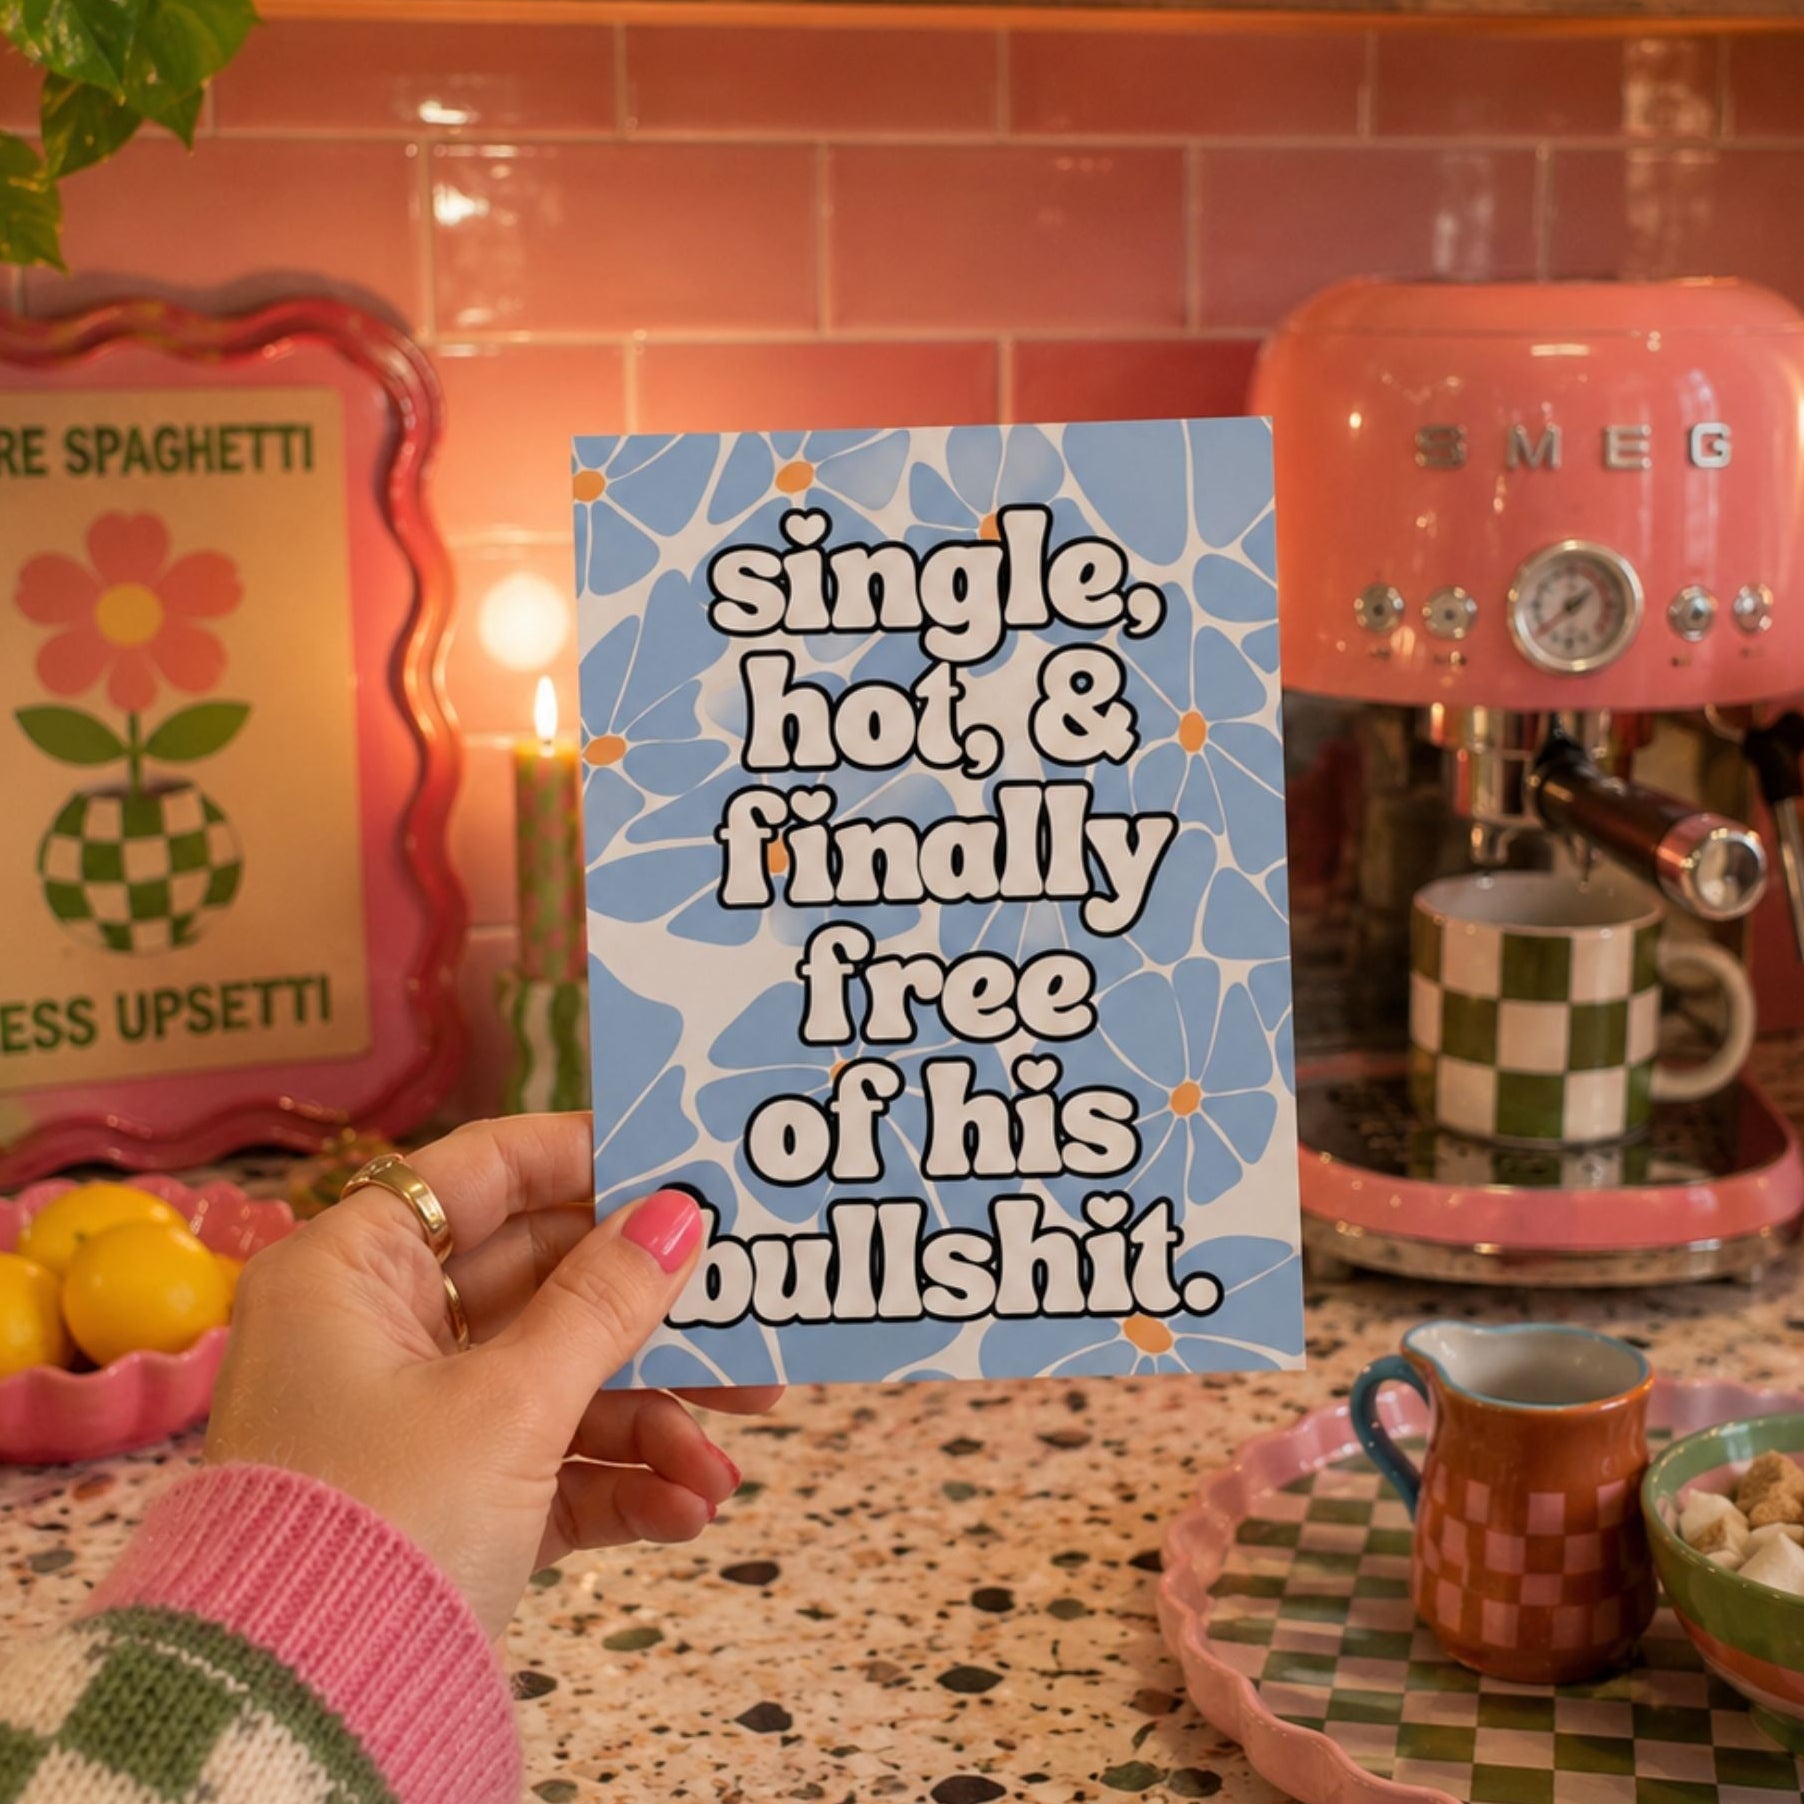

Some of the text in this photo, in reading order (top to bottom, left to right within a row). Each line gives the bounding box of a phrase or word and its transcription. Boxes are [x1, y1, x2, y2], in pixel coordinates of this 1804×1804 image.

[63, 423, 315, 477] SPAGHETTI
[1415, 422, 1733, 470] SMEG
[707, 503, 1168, 667] single,
[740, 643, 1141, 779] hot, &
[714, 780, 1179, 937] finally
[0, 975, 333, 1055] ESS UPSETTI
[796, 920, 1098, 1046] free
[744, 1053, 1143, 1185] of his
[662, 1186, 1226, 1328] bullshit.
